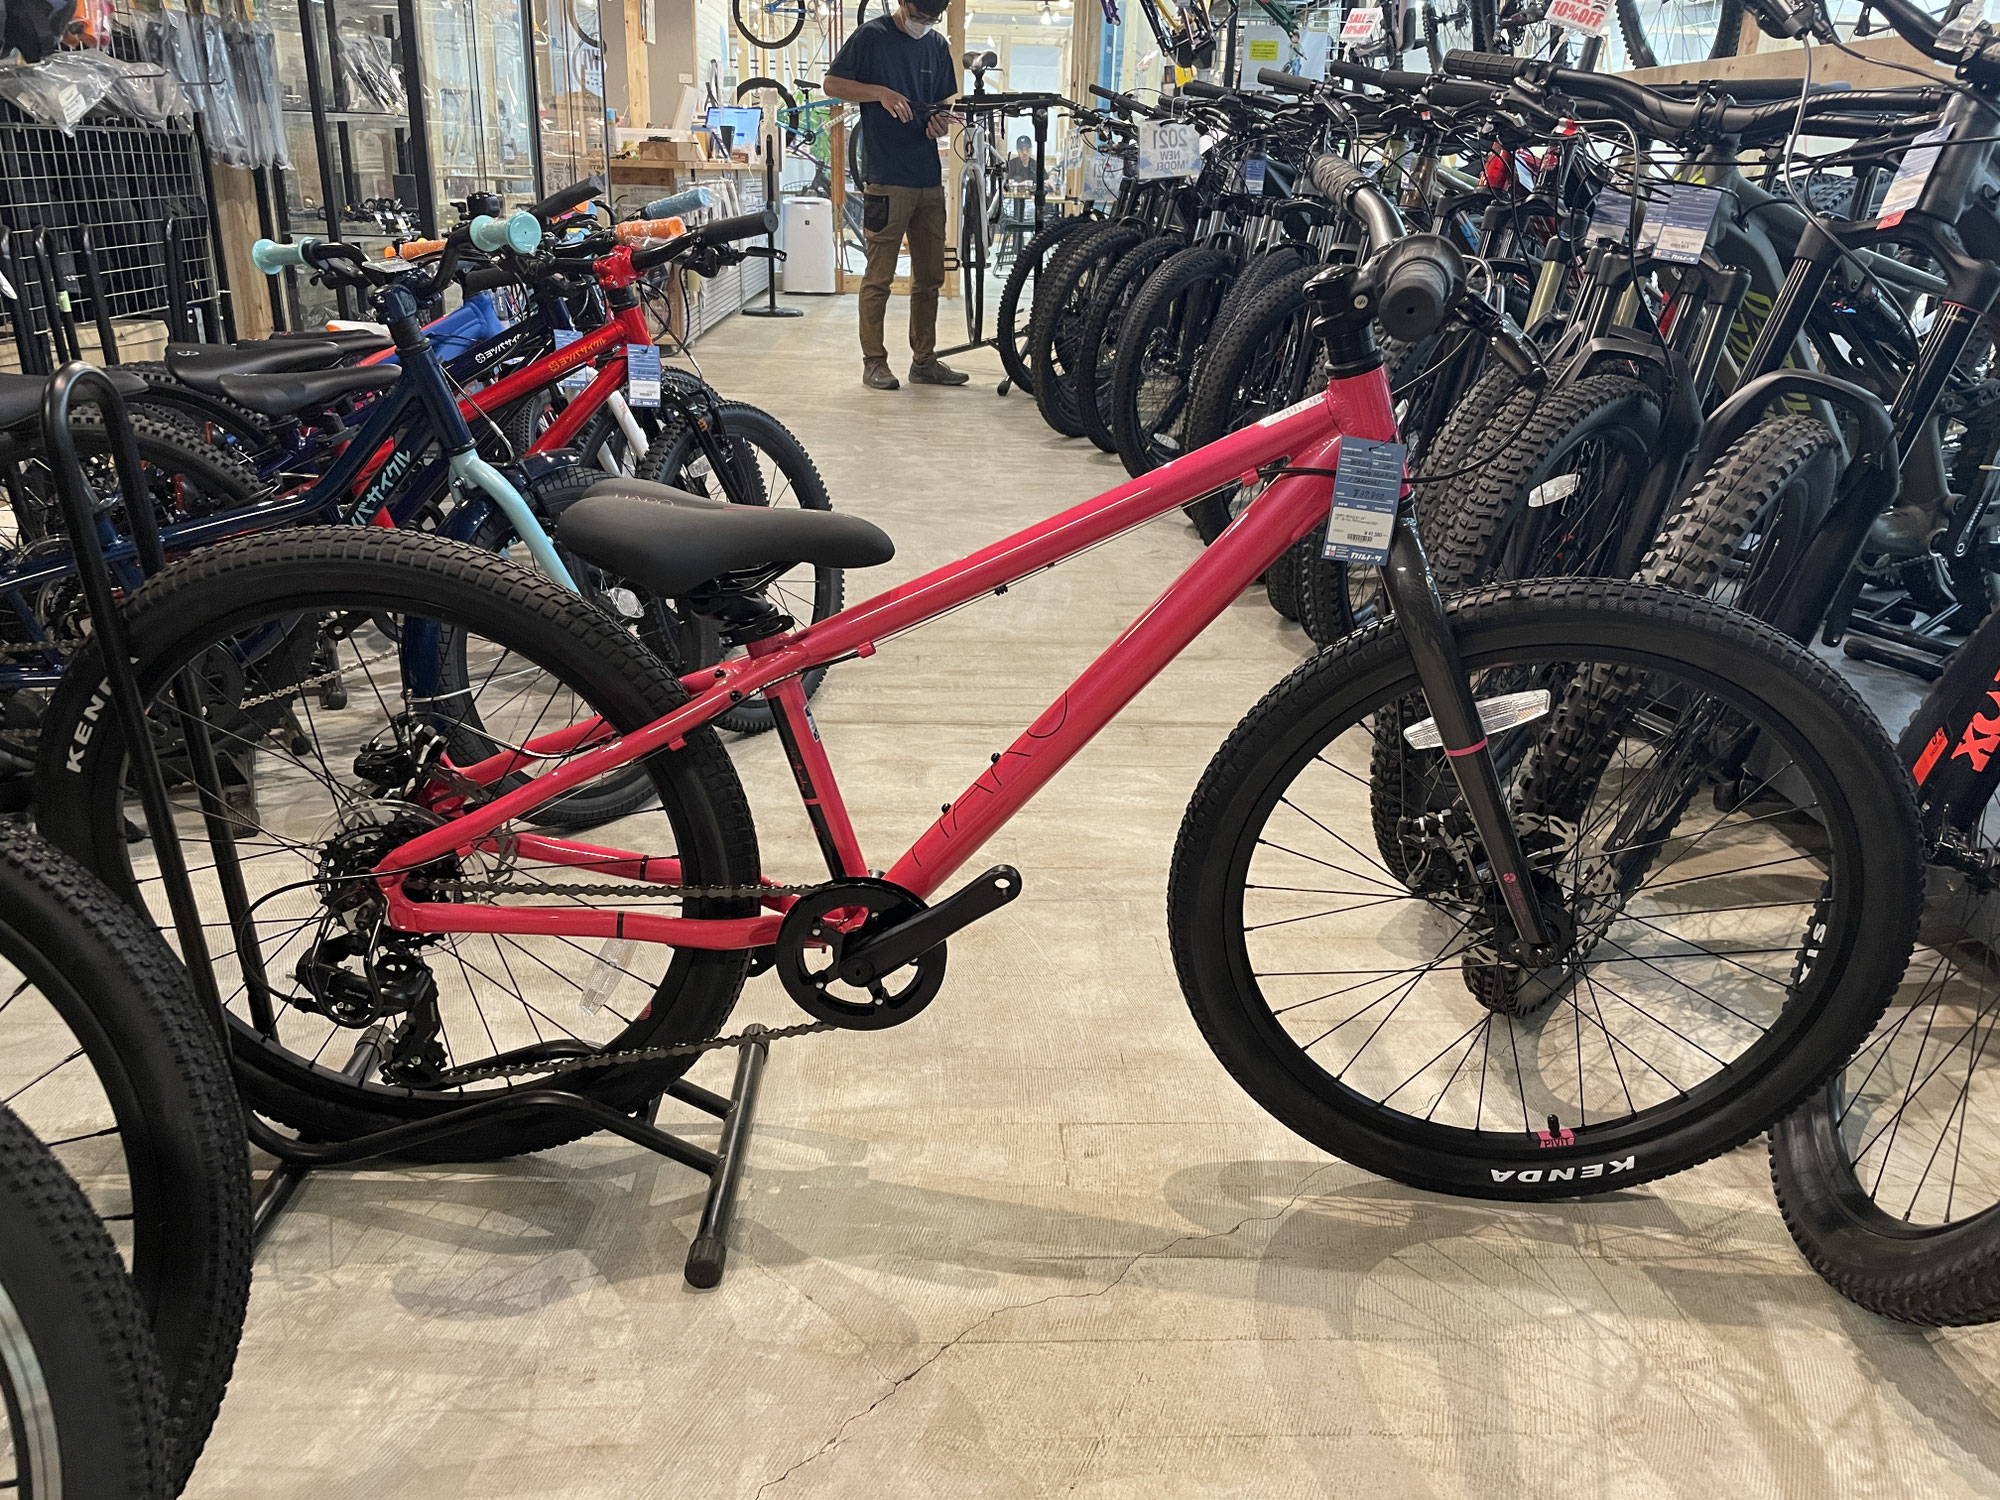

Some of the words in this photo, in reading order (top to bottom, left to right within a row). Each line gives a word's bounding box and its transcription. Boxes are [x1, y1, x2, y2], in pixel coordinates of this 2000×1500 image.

[1350, 13, 1367, 23] SALE
[1551, 1, 1604, 27] 10%OFF
[559, 338, 606, 367] ヨツバサイクル
[351, 450, 411, 526] バサイクル
[66, 676, 112, 773] KEN
[1490, 1155, 1635, 1183] KENDA
